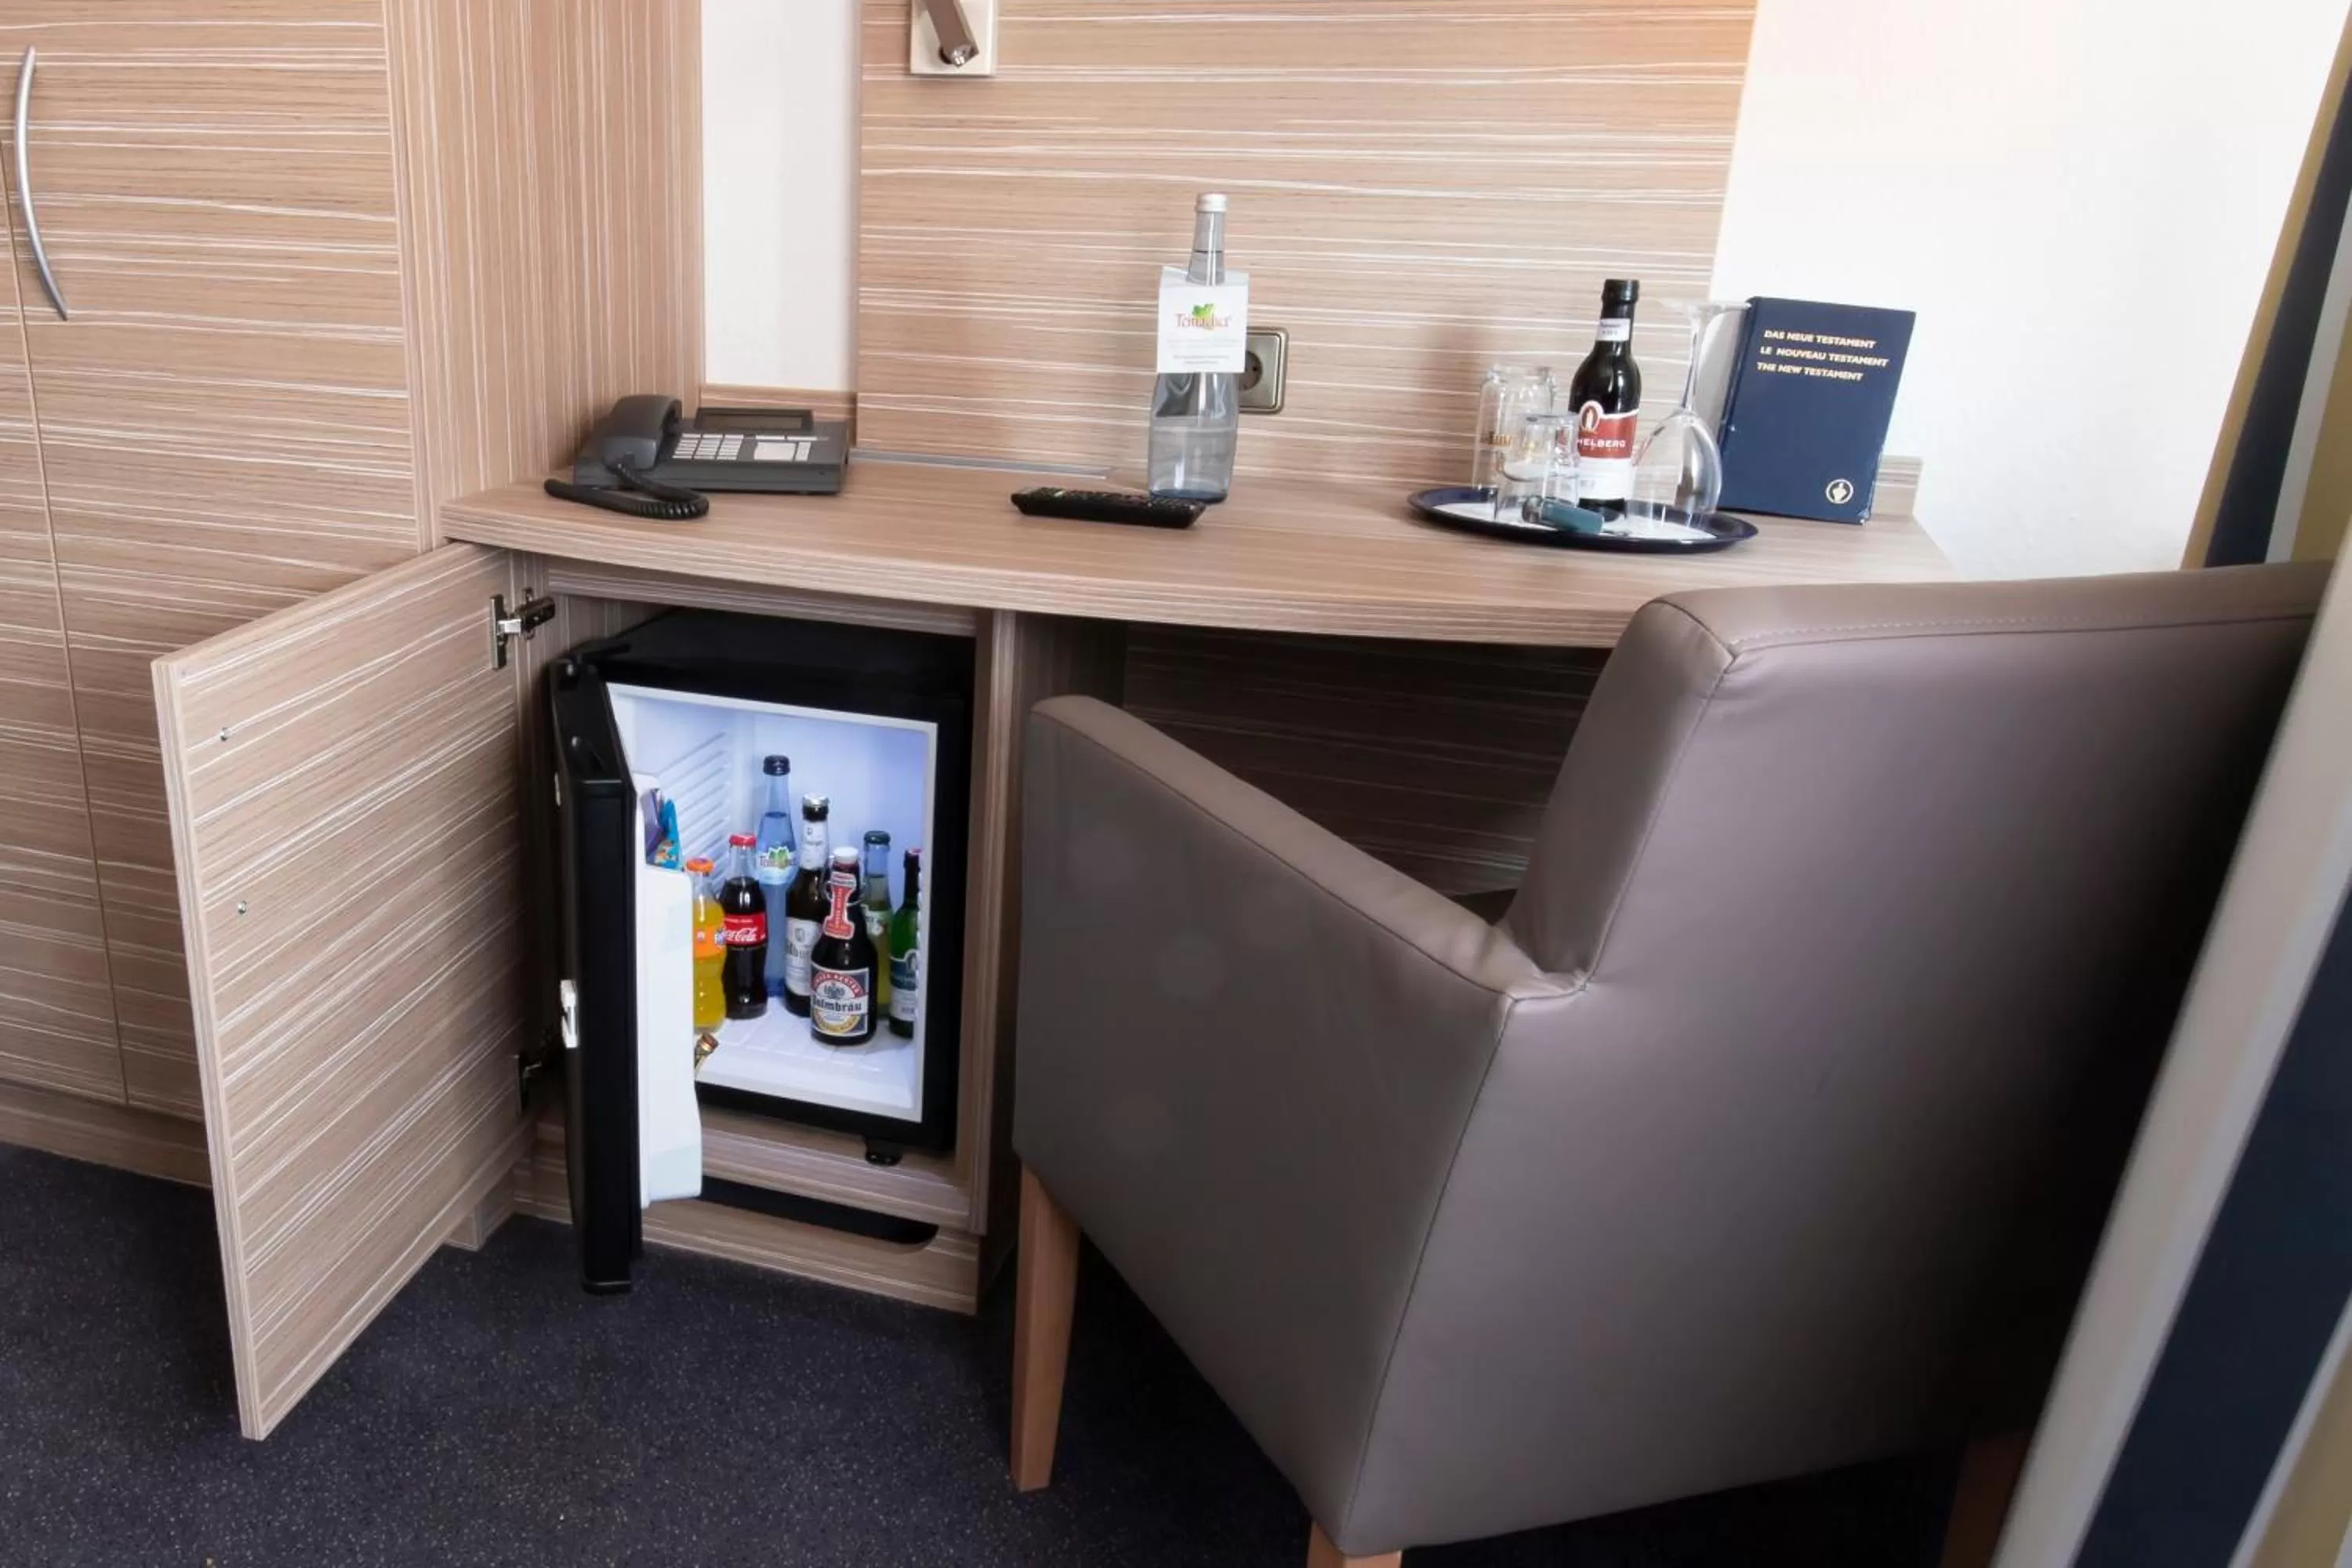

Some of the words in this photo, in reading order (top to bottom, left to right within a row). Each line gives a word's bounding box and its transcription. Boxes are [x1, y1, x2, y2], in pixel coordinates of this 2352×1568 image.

[1764, 329, 1785, 339] DAS
[1787, 332, 1814, 343] NEUE
[1816, 335, 1877, 349] TESTAMENT
[1760, 346, 1773, 355] LE
[1776, 347, 1827, 361] NOUVEAU
[1828, 353, 1889, 368] TESTAMENT
[1756, 361, 1777, 372] THE
[1777, 365, 1802, 374] NEW
[1802, 366, 1864, 381] TESTAMENT
